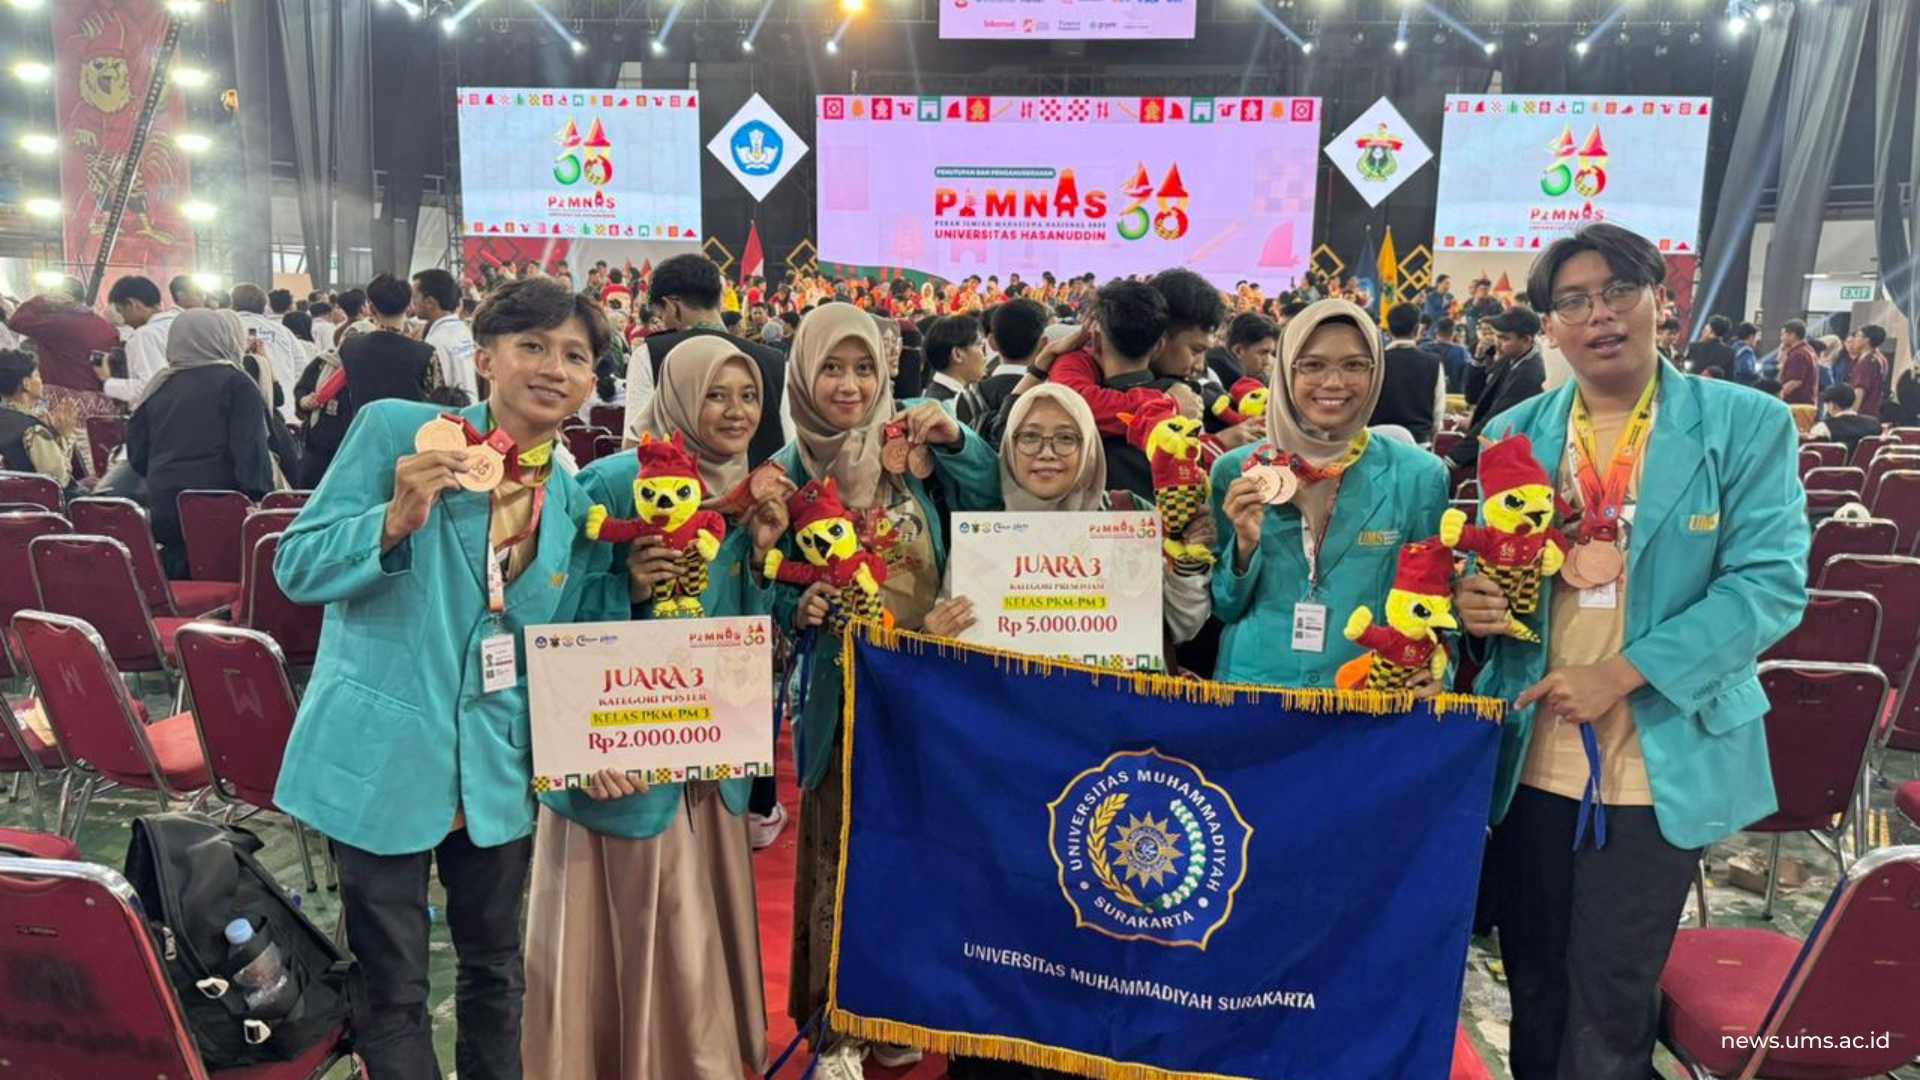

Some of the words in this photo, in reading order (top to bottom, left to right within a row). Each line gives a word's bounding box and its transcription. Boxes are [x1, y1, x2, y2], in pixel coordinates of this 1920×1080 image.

[934, 168, 1107, 219] PIMNAS
[935, 229, 1017, 240] UNIVERSITAS
[1021, 230, 1106, 241] HASANUDDIN
[1842, 287, 1871, 299] EXIT
[1014, 554, 1089, 578] JUARA
[1091, 557, 1101, 577] 3
[1005, 597, 1044, 607] KELAS
[998, 616, 1023, 637] Rp
[1026, 615, 1118, 633] 5.000.000
[602, 666, 688, 692] JUARA
[693, 667, 705, 686] 3
[599, 696, 658, 706] KATEGORI
[661, 693, 708, 703] POSTER
[593, 711, 639, 724] KELAS
[641, 709, 698, 721] PKM-PM
[588, 726, 721, 754] Rp2.000.000
[1067, 770, 1129, 871] UNIVERSITAS
[1136, 769, 1226, 892] MUHAMMADIYAH
[1094, 896, 1195, 928] SURAKARTA
[964, 942, 1066, 977] UNIVERSITAS
[1070, 969, 1213, 1010] MUHAMMADIYAH
[1218, 991, 1315, 1010] SURAKARTA
